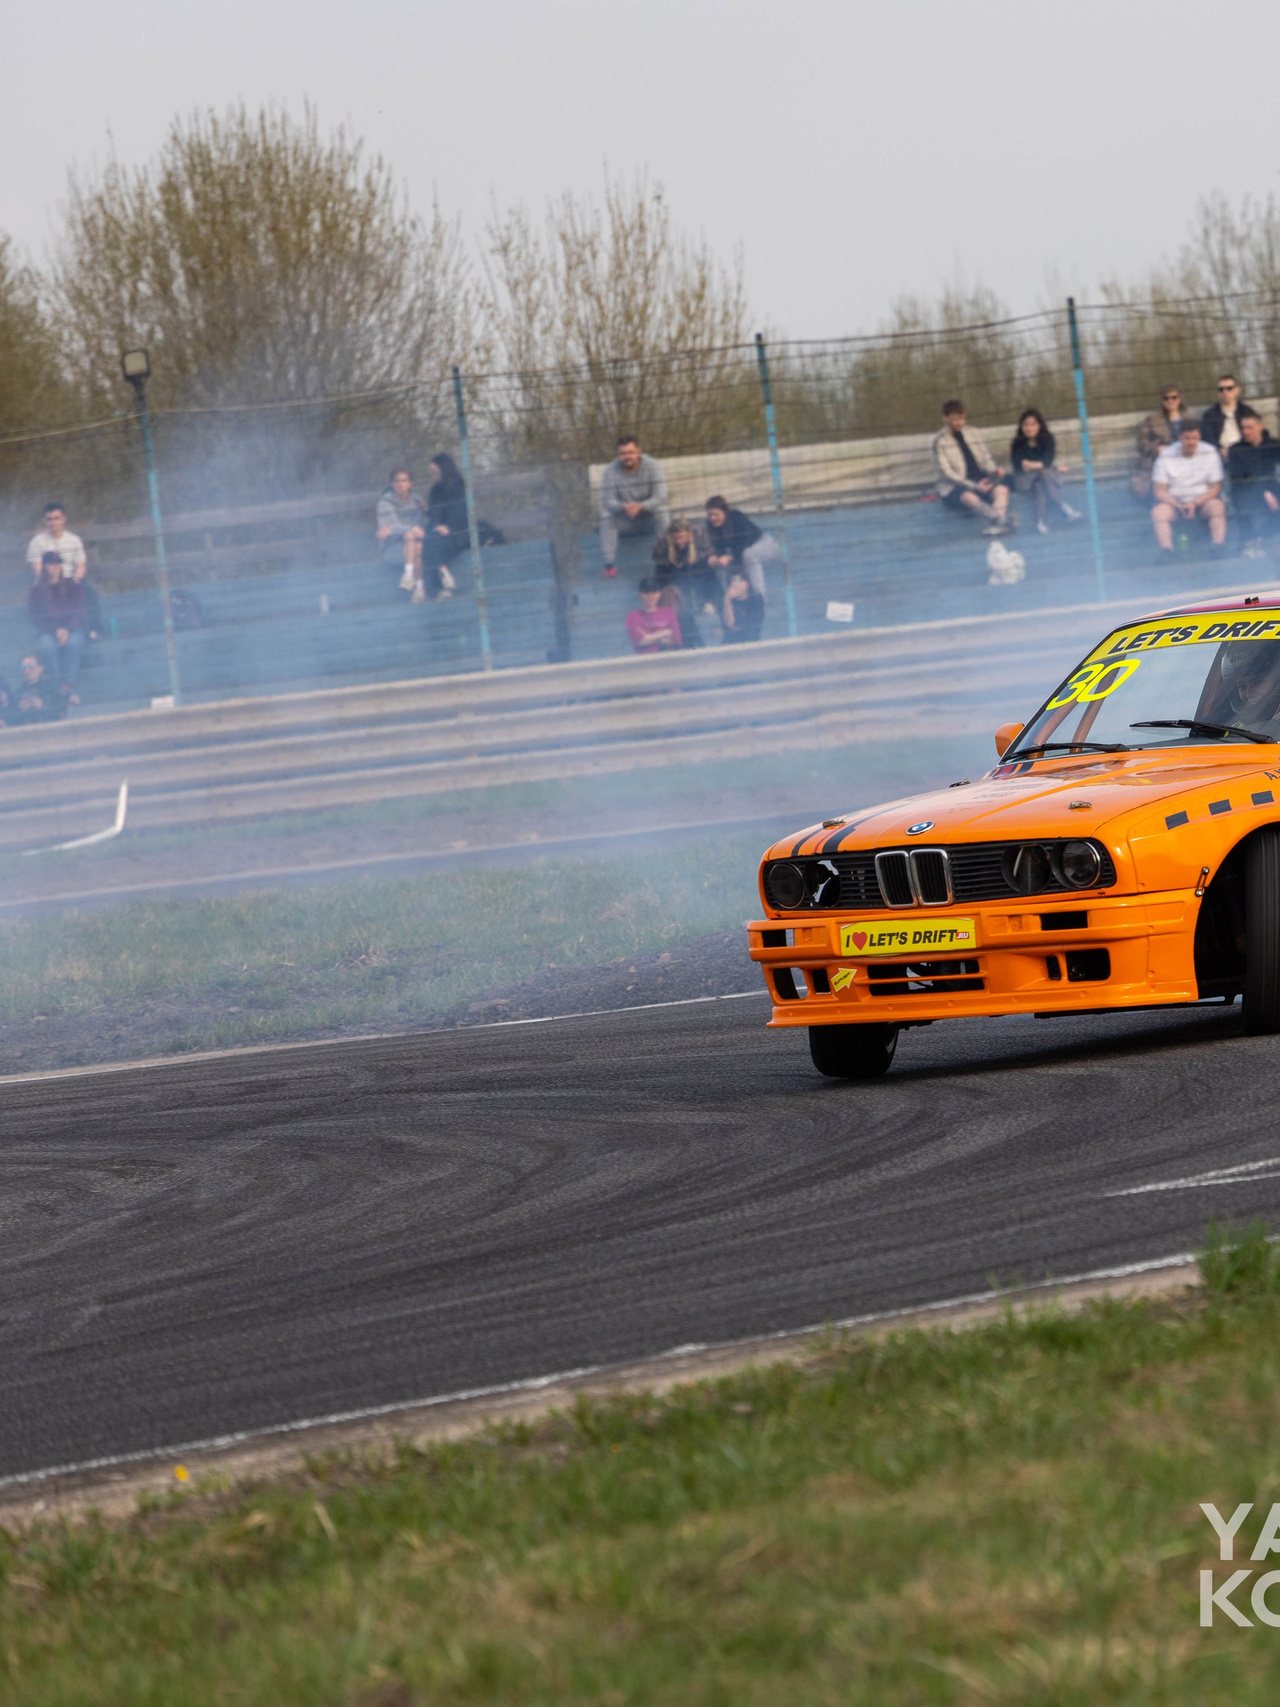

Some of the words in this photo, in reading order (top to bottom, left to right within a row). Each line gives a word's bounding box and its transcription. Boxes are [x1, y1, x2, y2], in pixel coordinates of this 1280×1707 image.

[1108, 625, 1199, 654] LET'S
[1046, 659, 1140, 710] 30
[869, 932, 908, 947] LET'S
